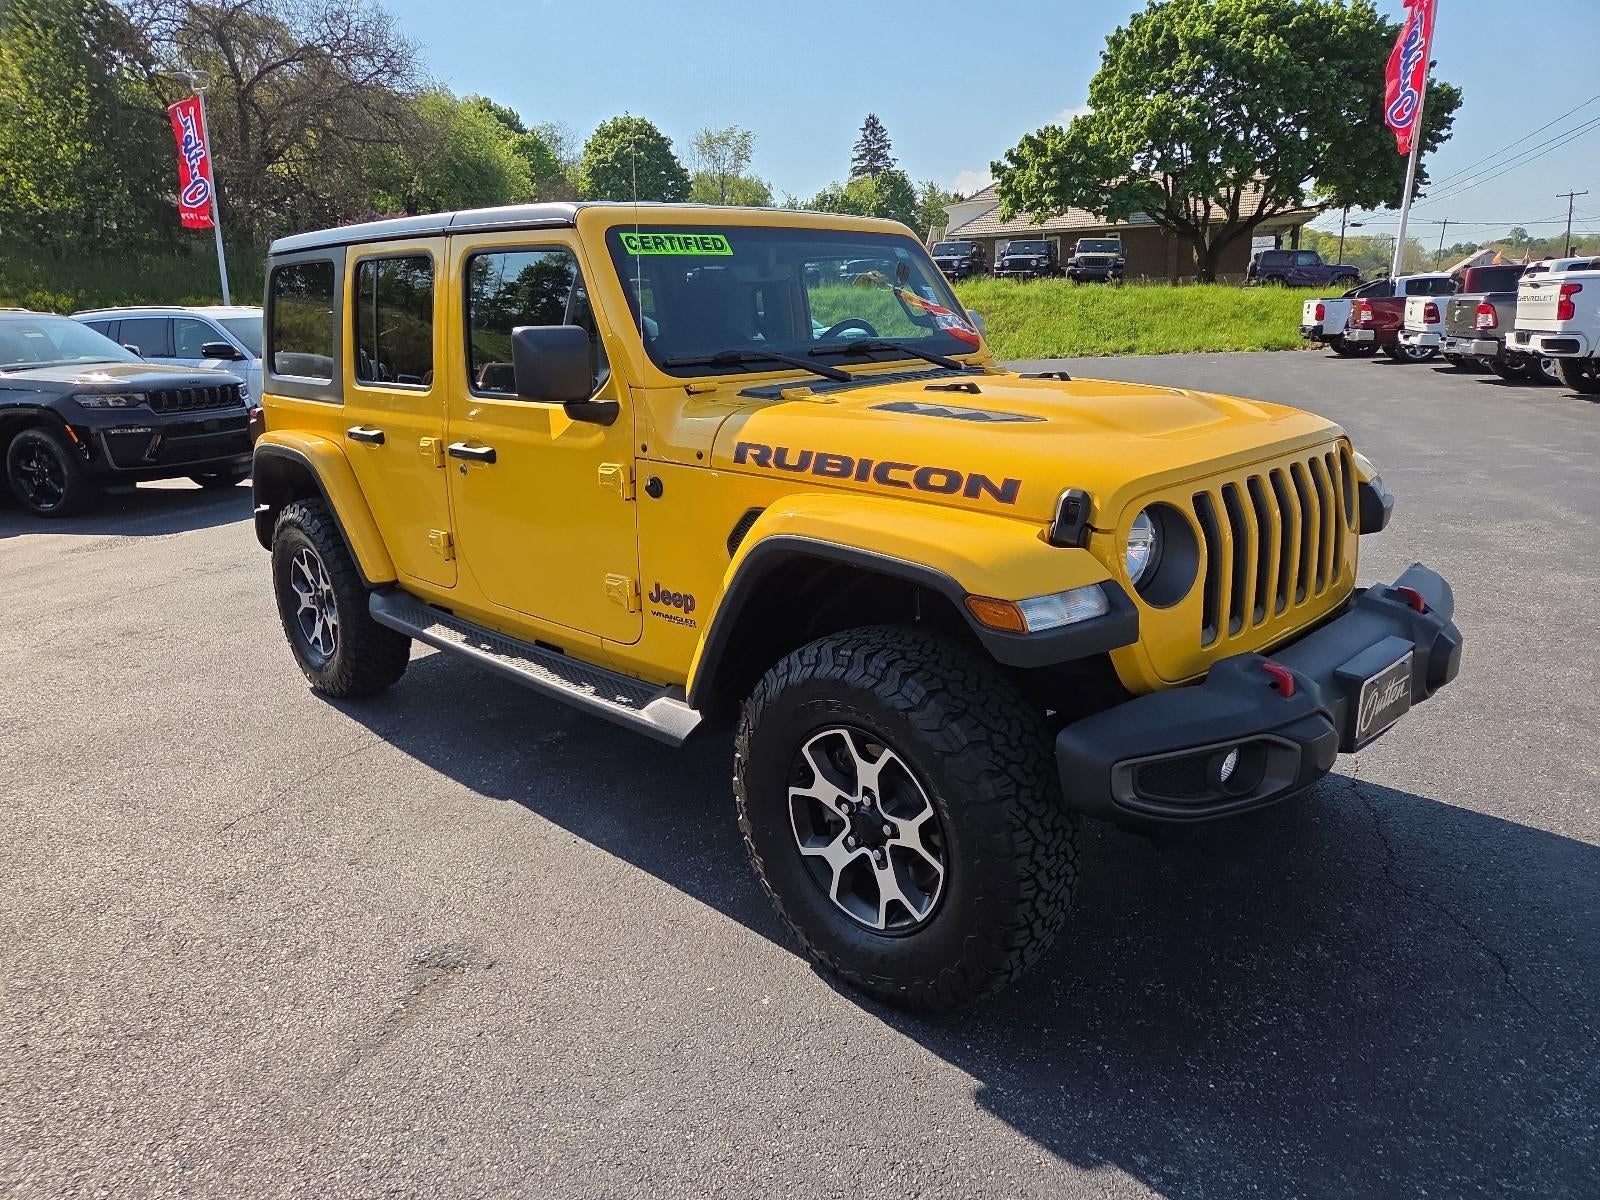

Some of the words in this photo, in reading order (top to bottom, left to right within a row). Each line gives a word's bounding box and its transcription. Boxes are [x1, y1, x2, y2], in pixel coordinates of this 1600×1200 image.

[625, 235, 726, 251] CERTIFIED
[1517, 294, 1553, 302] CHEVROLET
[733, 441, 1022, 505] RUBICON
[648, 582, 696, 615] Jeep
[651, 609, 696, 626] WRANGLER
